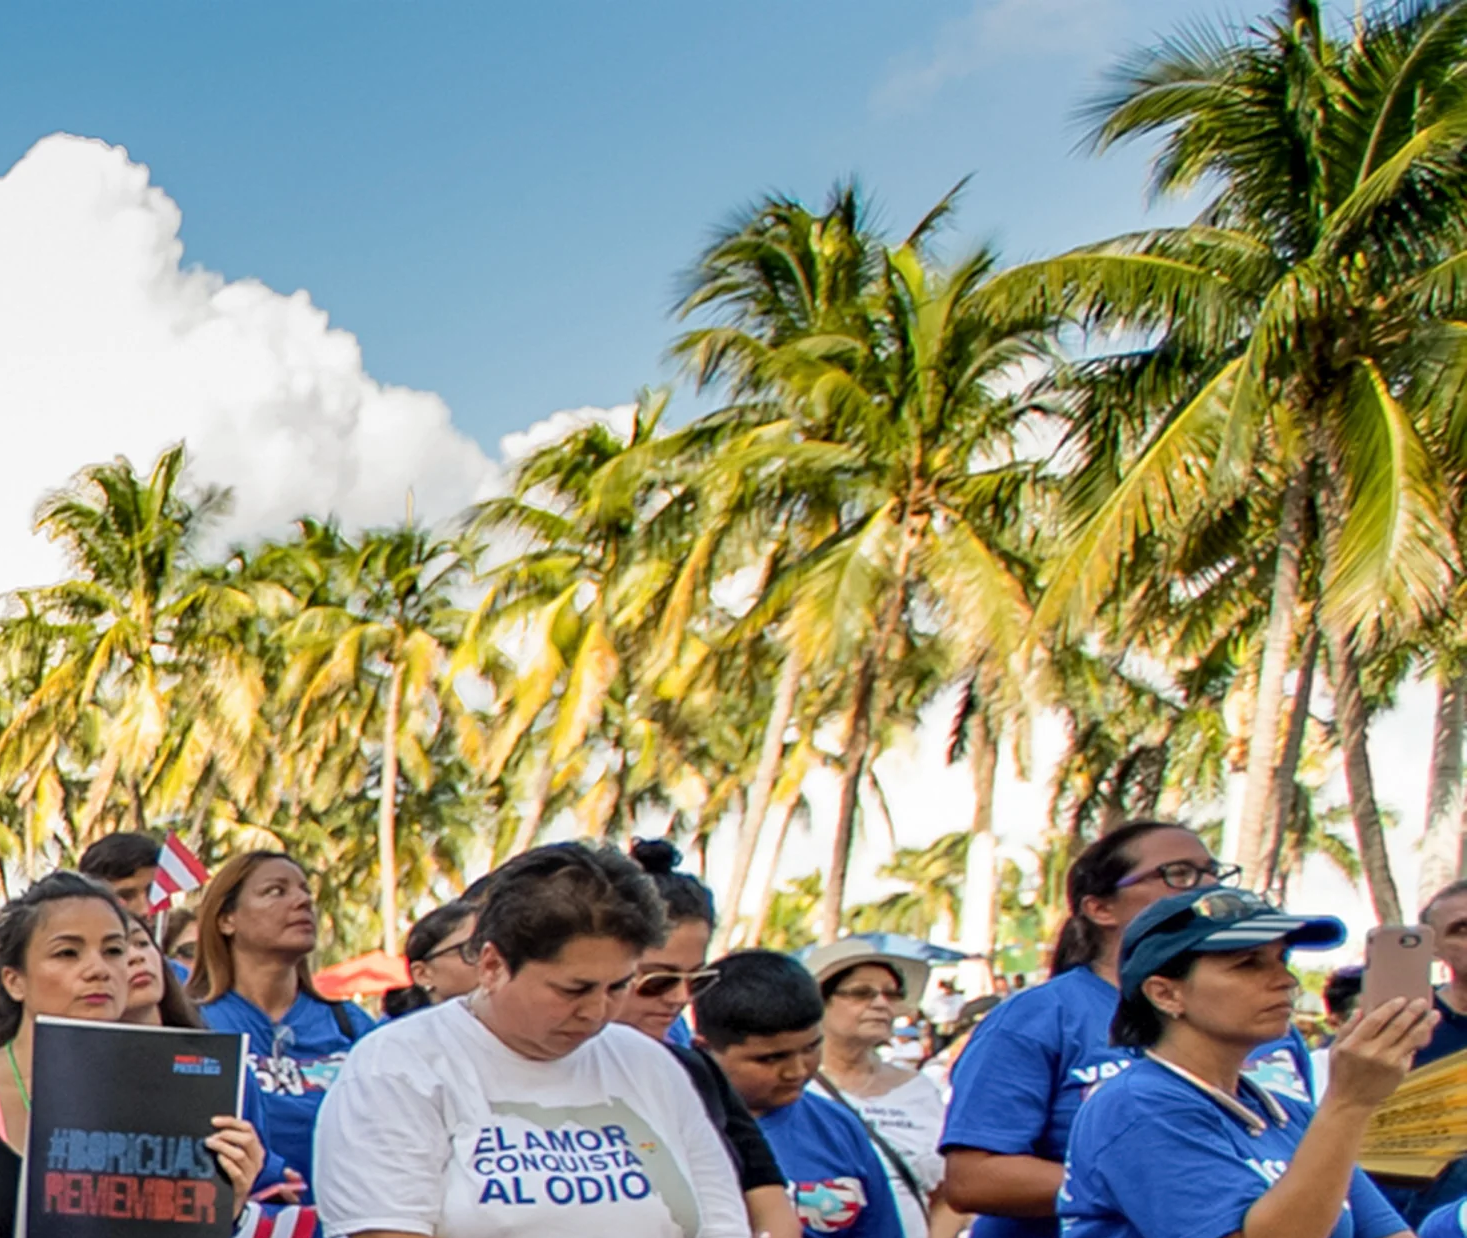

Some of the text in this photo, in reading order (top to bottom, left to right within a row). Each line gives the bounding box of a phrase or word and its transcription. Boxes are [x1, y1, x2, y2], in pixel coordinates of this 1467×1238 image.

[47, 1128, 216, 1178] #BORICUAS
[474, 1125, 631, 1155] EL AMOR
[474, 1149, 644, 1176] CONQUISTA
[44, 1172, 216, 1223] REMEMBER
[479, 1171, 652, 1205] AL ODIO
